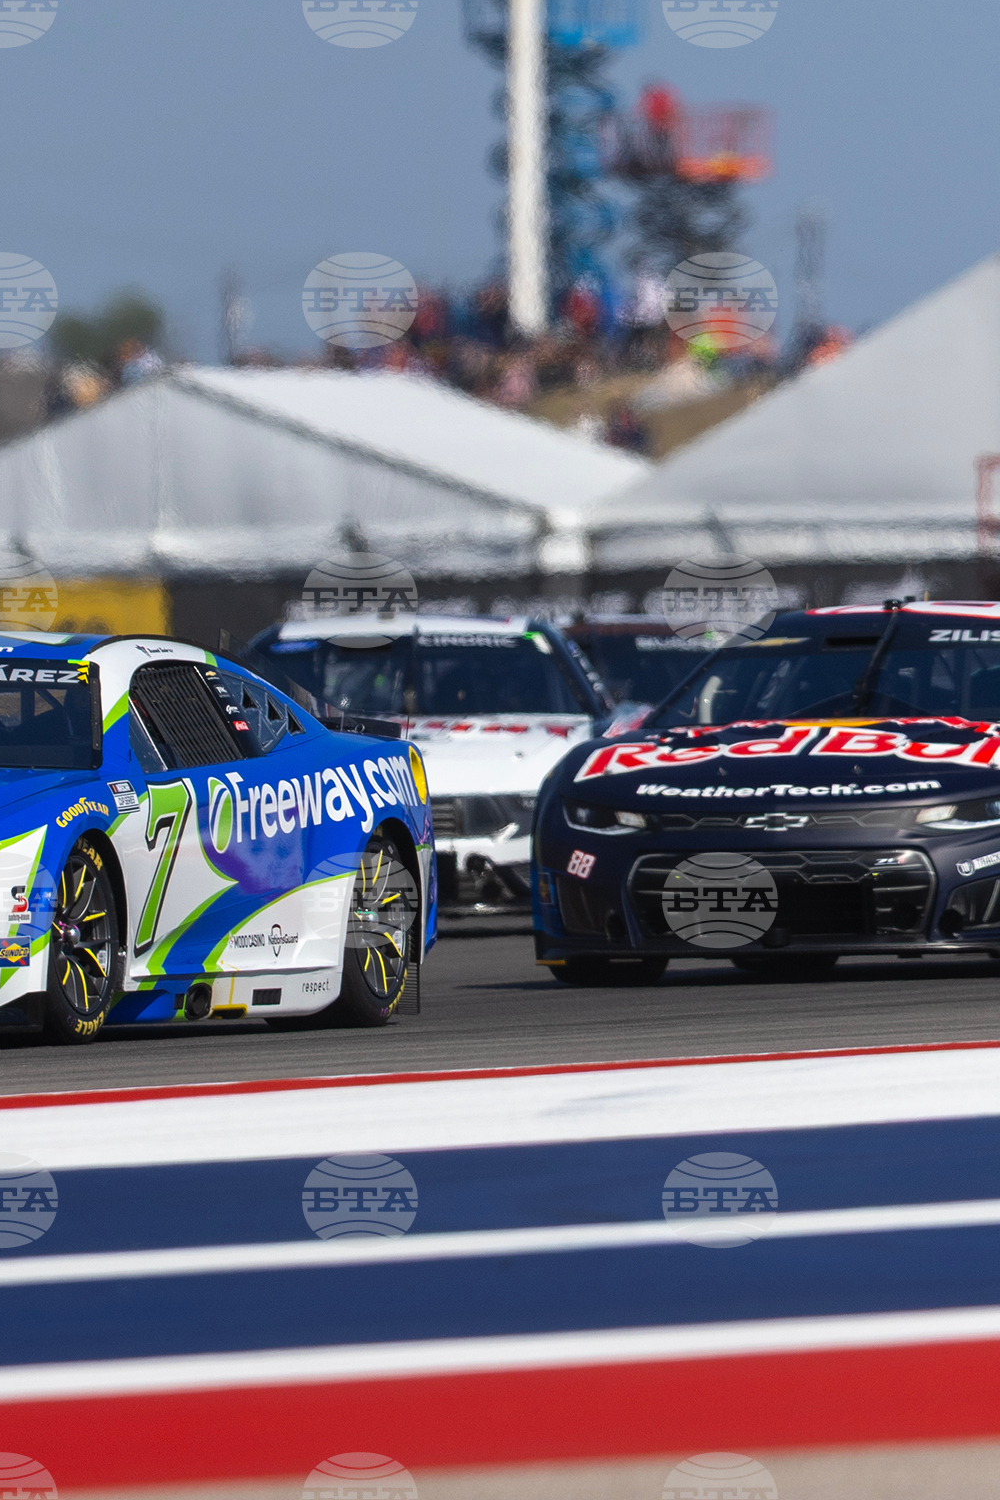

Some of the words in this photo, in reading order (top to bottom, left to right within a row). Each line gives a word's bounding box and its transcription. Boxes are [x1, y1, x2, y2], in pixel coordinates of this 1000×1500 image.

[56, 797, 109, 828] GOODYEAR
[226, 753, 416, 842] Freeway.com
[134, 777, 193, 959] 7
[566, 849, 596, 879] 88
[75, 1011, 104, 1035] EAGLE
